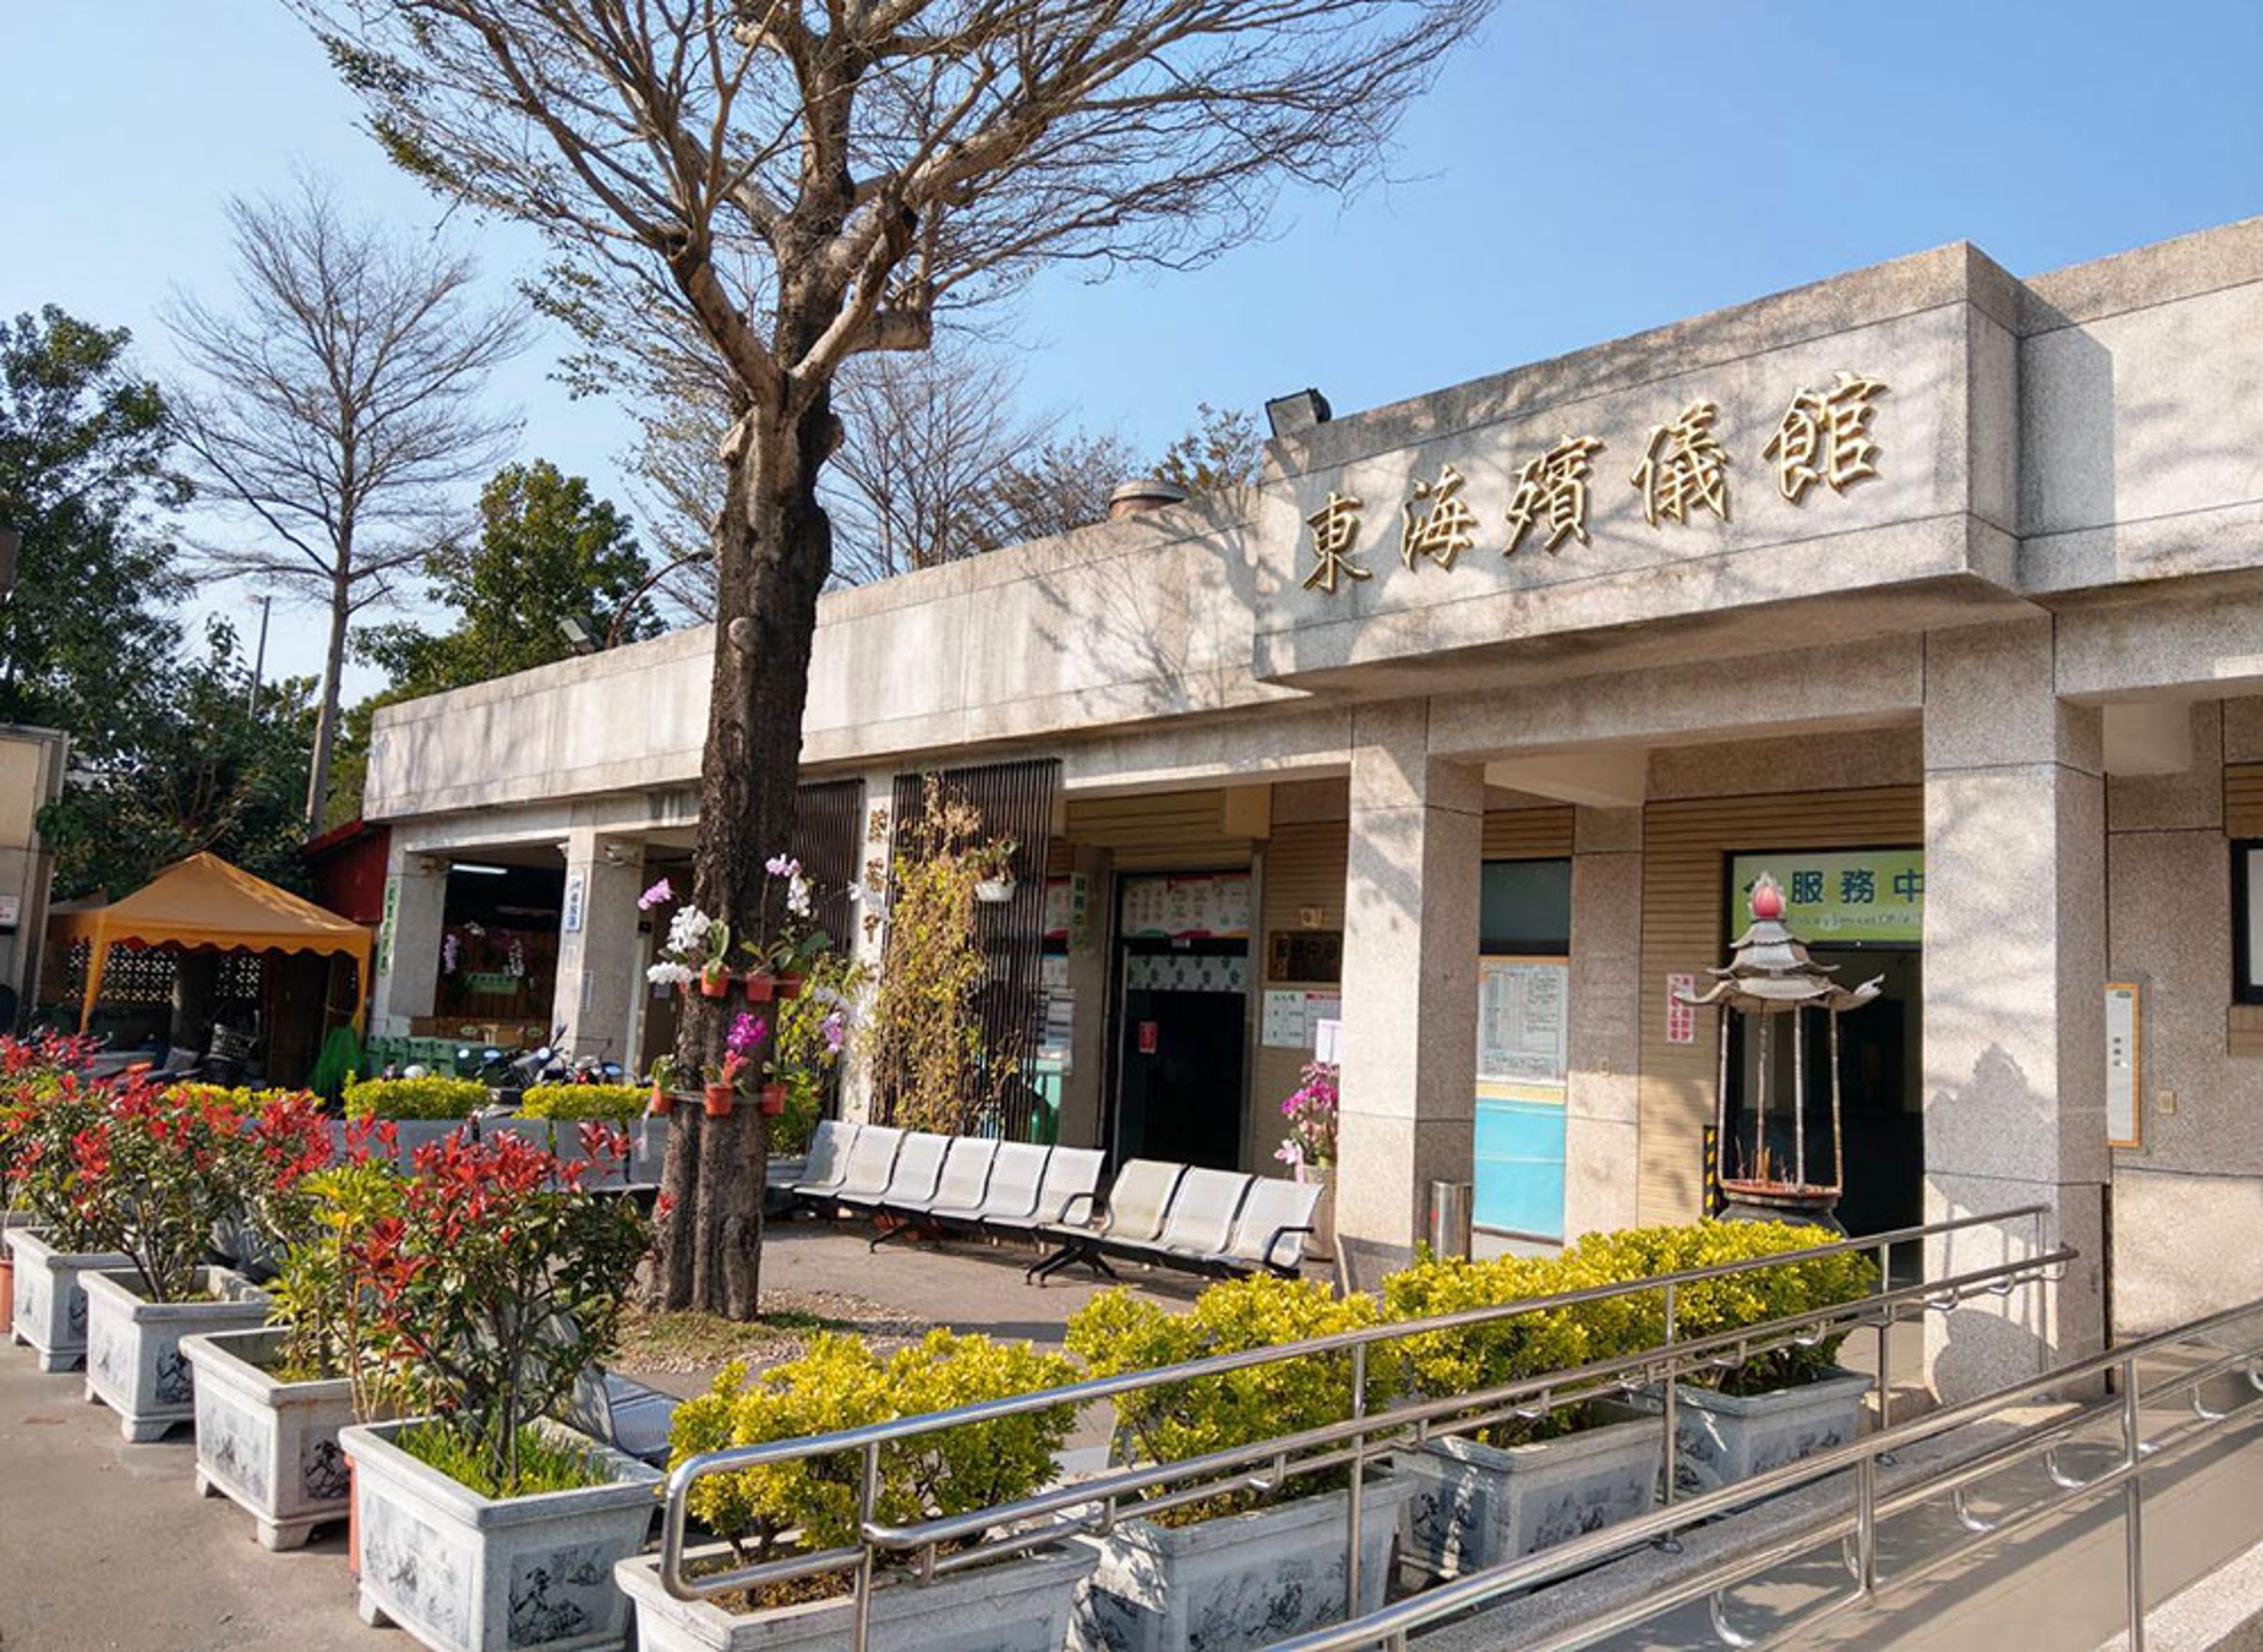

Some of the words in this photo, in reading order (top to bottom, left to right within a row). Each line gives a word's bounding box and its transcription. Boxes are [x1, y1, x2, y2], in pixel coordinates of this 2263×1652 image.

[1302, 371, 1889, 594] 東海殯儀館
[1792, 868, 1924, 904] 服務中
